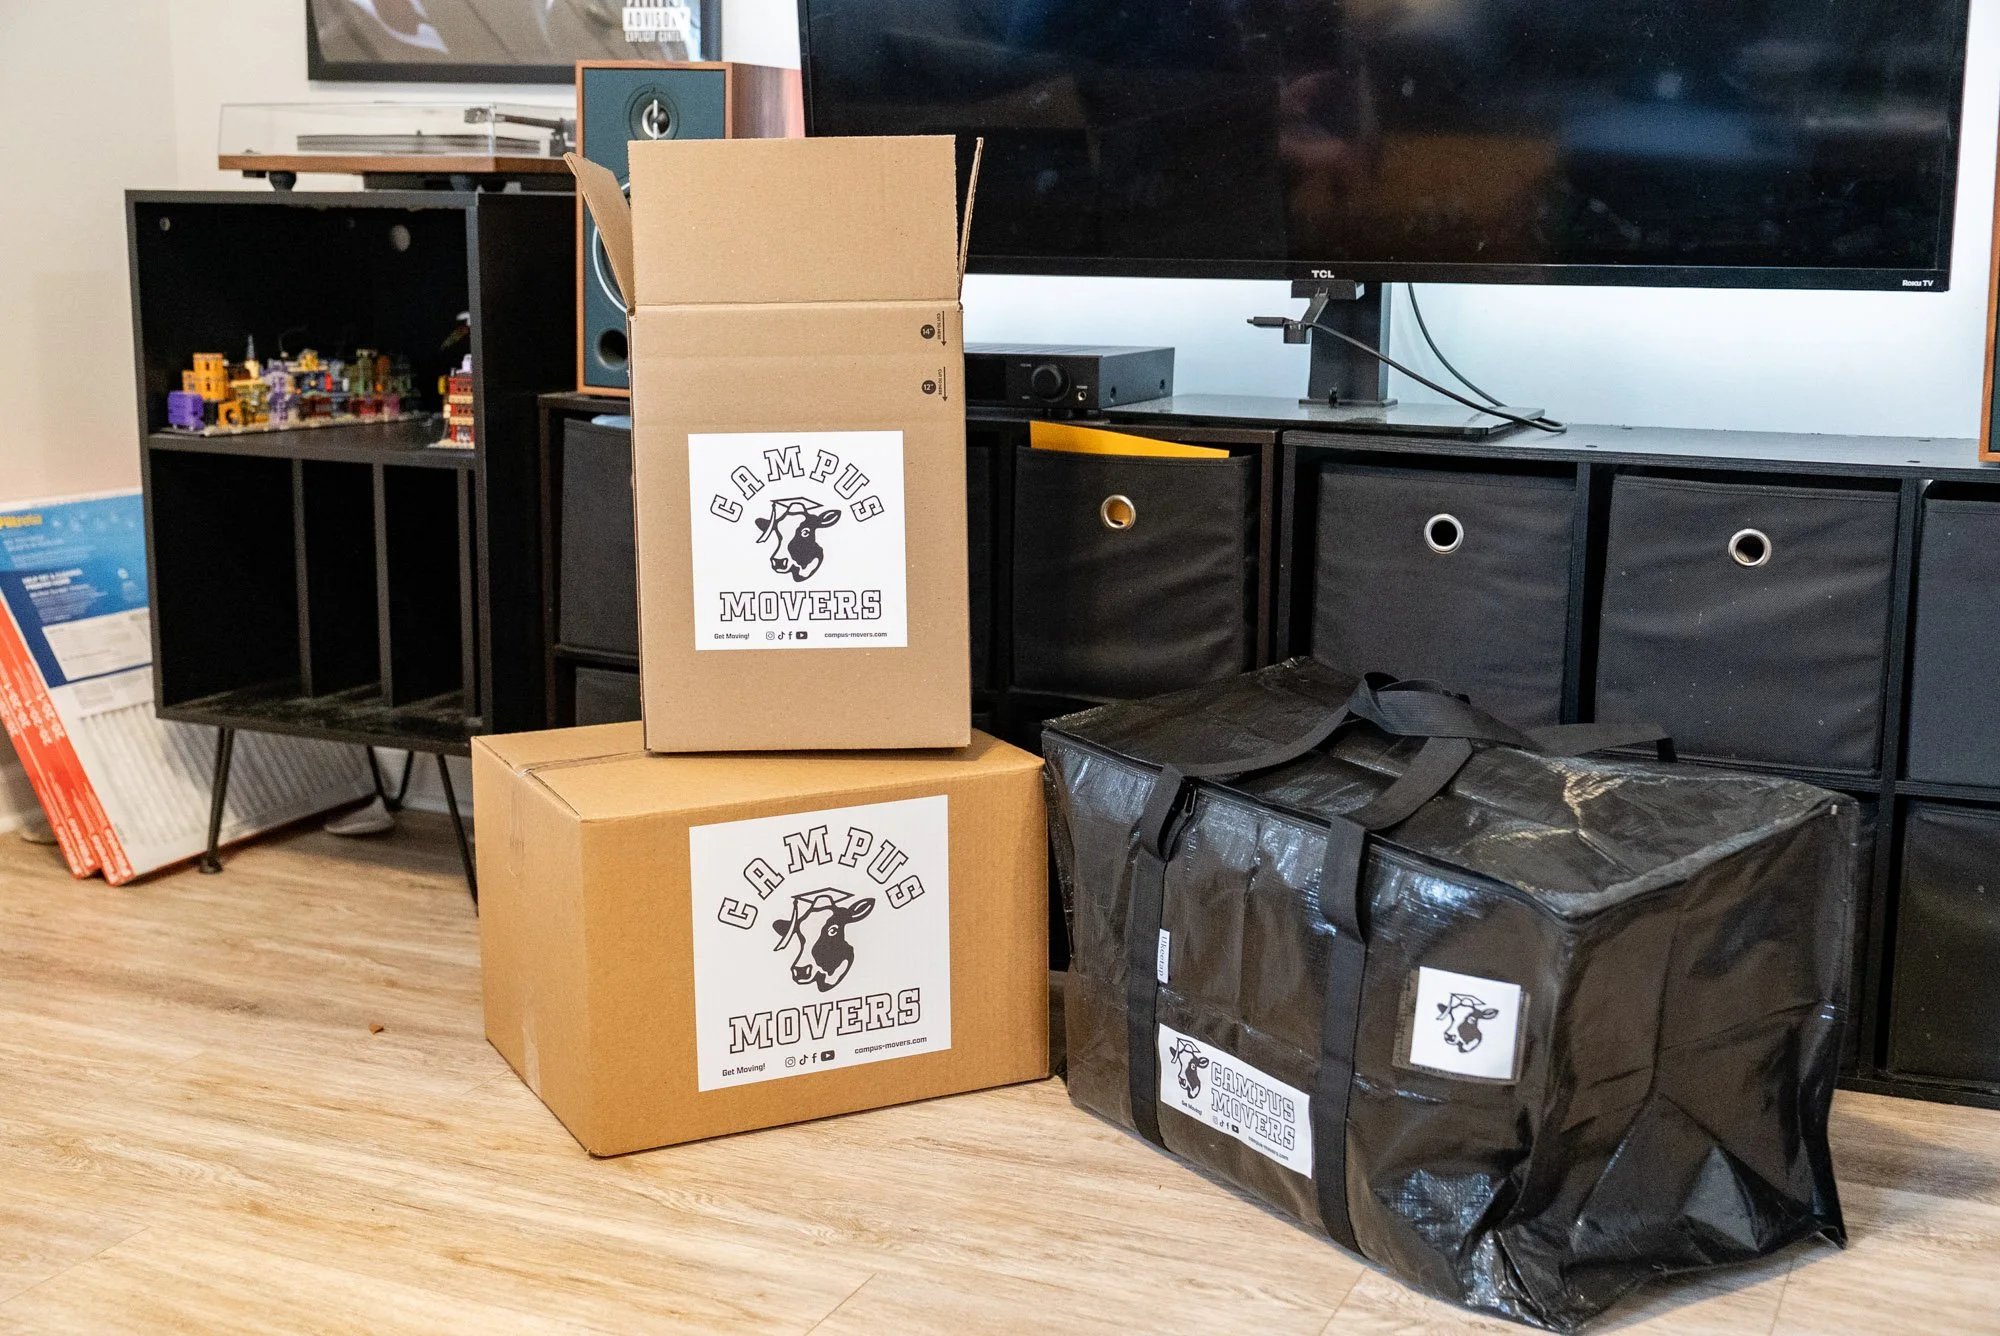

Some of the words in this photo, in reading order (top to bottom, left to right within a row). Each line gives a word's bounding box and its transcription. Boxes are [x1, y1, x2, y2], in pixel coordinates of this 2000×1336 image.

[1311, 270, 1335, 278] TCL
[710, 445, 884, 523] CAMPUS
[720, 590, 882, 621] MOVERS
[726, 633, 750, 641] Moving!
[824, 631, 888, 639] campus-movers.com
[717, 825, 925, 930] CAMPUS
[729, 987, 921, 1054] MOVERS
[721, 1068, 735, 1077] Get
[736, 1063, 766, 1075] Moving!
[854, 1036, 928, 1054] campus-movers.com
[1210, 1061, 1295, 1124] CAMPUS
[1211, 1088, 1296, 1151] MOVERS
